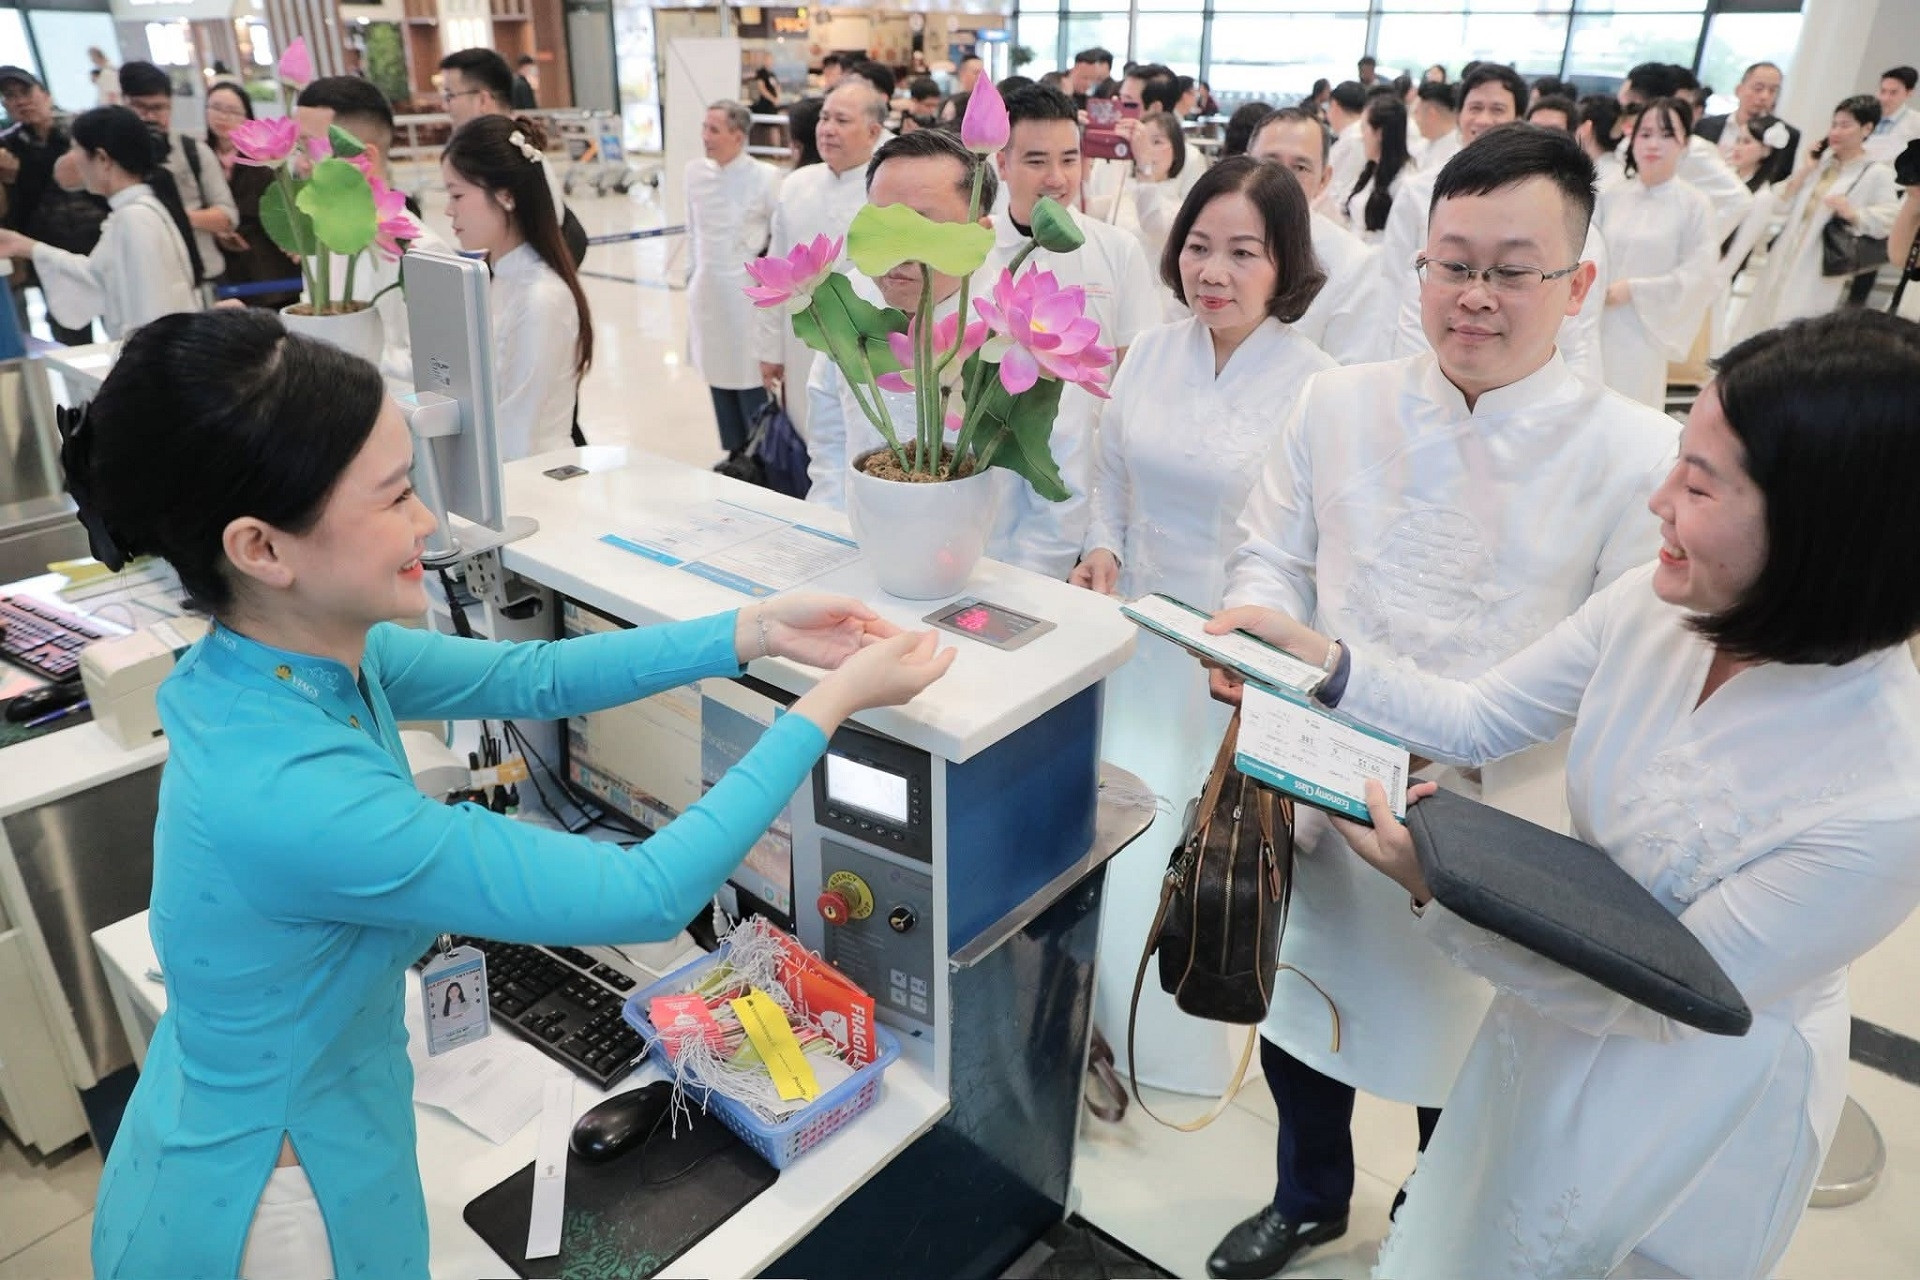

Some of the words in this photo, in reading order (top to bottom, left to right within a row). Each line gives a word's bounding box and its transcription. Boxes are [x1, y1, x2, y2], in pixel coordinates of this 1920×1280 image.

[292, 675, 320, 699] VIAGS
[1293, 780, 1315, 797] Class
[1314, 786, 1350, 810] Economy
